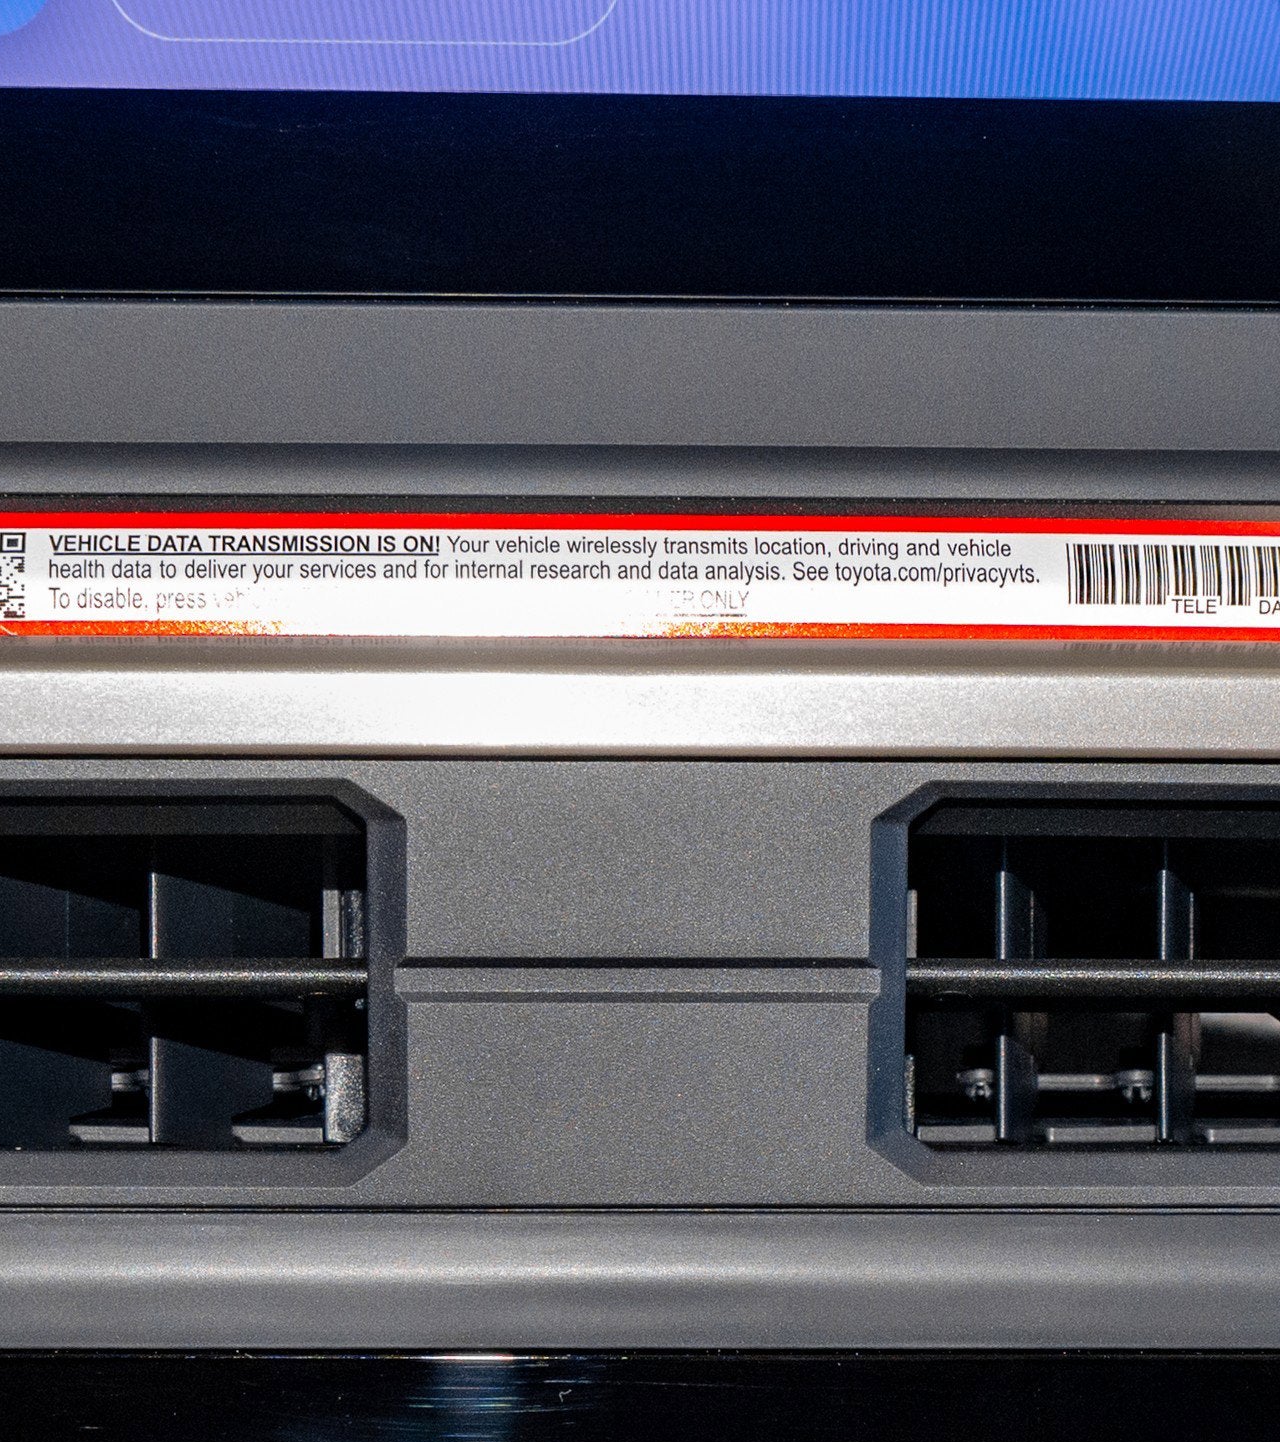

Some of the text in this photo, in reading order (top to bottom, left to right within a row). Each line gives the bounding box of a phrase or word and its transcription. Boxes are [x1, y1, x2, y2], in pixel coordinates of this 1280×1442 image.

[48, 534, 1012, 560] VEHICLE DATA TRANSMISSION IS ON! Your vehicle wirelessly transmits location, driving and vehicle
[48, 558, 1040, 588] health data to deliver your services and for internal research and data analysis. See toyota.com/privacyvts.
[47, 586, 71, 609] To
[155, 591, 207, 613] press
[700, 589, 750, 610] ONLY
[1171, 598, 1218, 615] TELE
